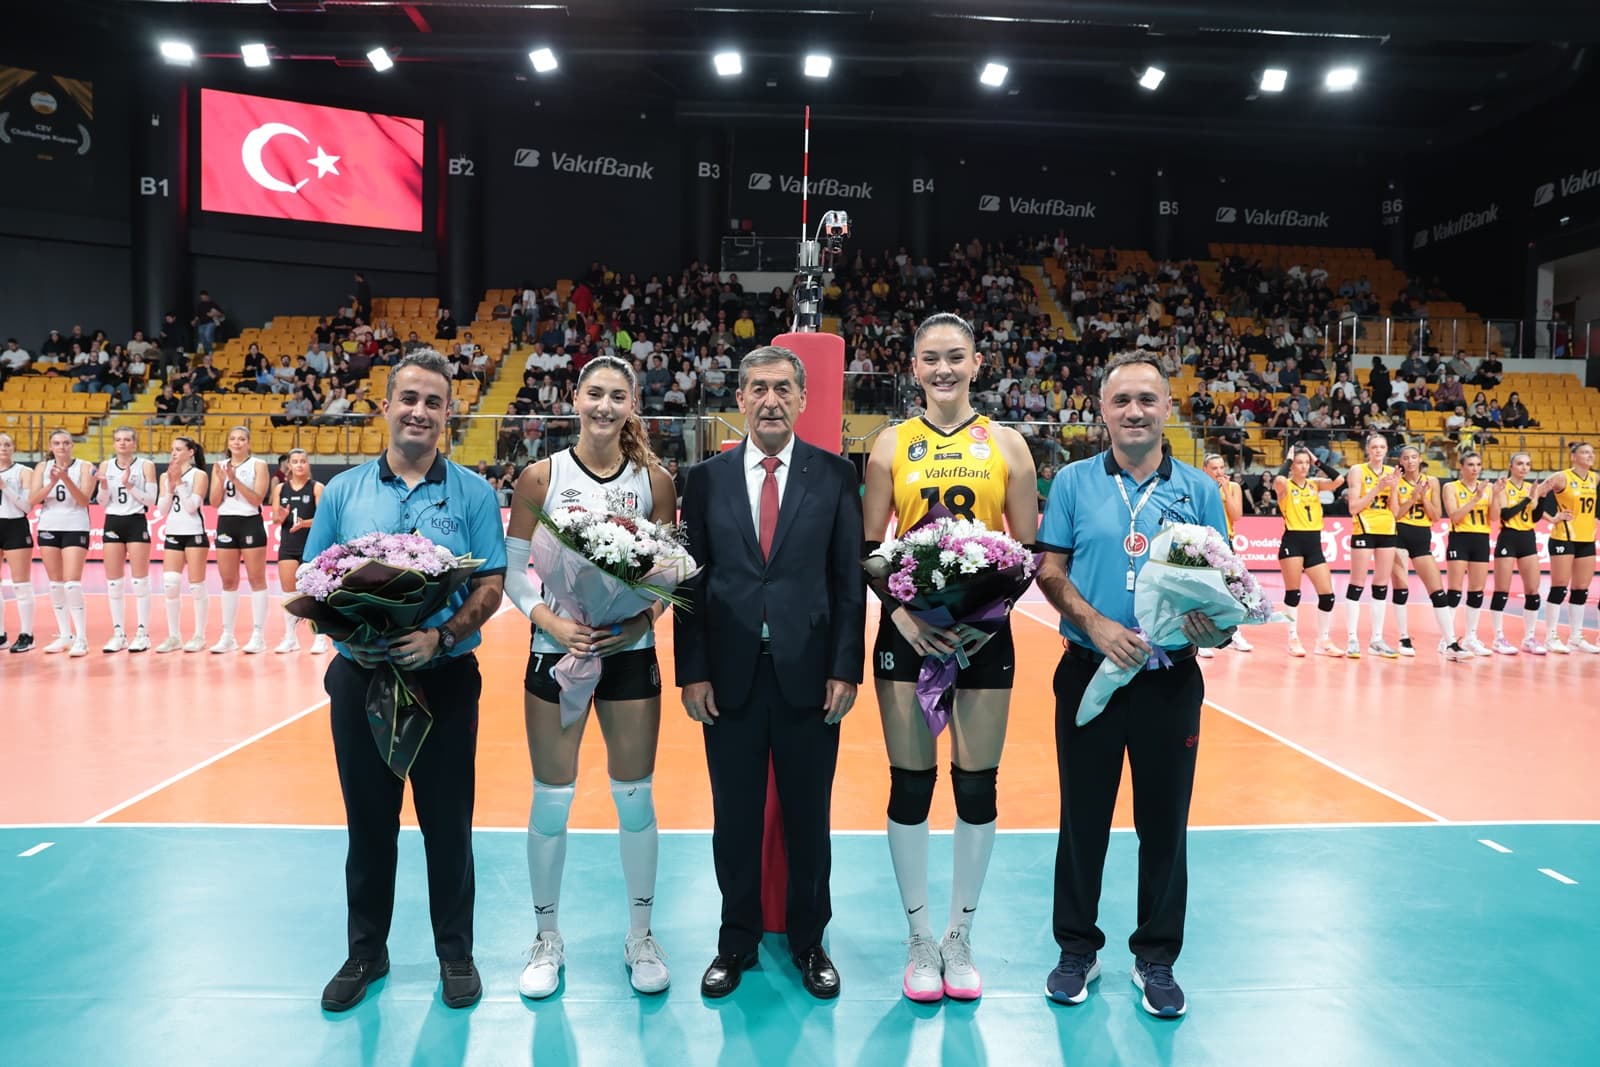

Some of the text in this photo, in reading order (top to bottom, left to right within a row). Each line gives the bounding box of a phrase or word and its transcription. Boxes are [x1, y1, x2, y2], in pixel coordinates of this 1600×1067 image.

[448, 158, 475, 176] B2
[552, 151, 655, 180] VakıfBank
[698, 161, 720, 180] B3
[140, 176, 169, 197] B1
[912, 178, 935, 193] B4
[1561, 168, 1600, 197] Vakı
[1009, 196, 1097, 218] VakıfBank
[1159, 200, 1179, 215] B5
[1382, 198, 1403, 214] B6
[1244, 208, 1330, 228] VakıfBank
[925, 466, 991, 480] VakıfBank
[56, 484, 66, 502] 6
[118, 486, 127, 504] 5
[226, 480, 236, 497] 9
[172, 495, 181, 512] 3
[920, 485, 976, 524] 18
[1370, 495, 1388, 509] 23
[1409, 503, 1425, 519] 15
[1579, 497, 1594, 514] 19
[1304, 505, 1312, 522] 1
[1469, 509, 1485, 525] 11
[534, 653, 544, 673] 7
[879, 651, 895, 671] 18
